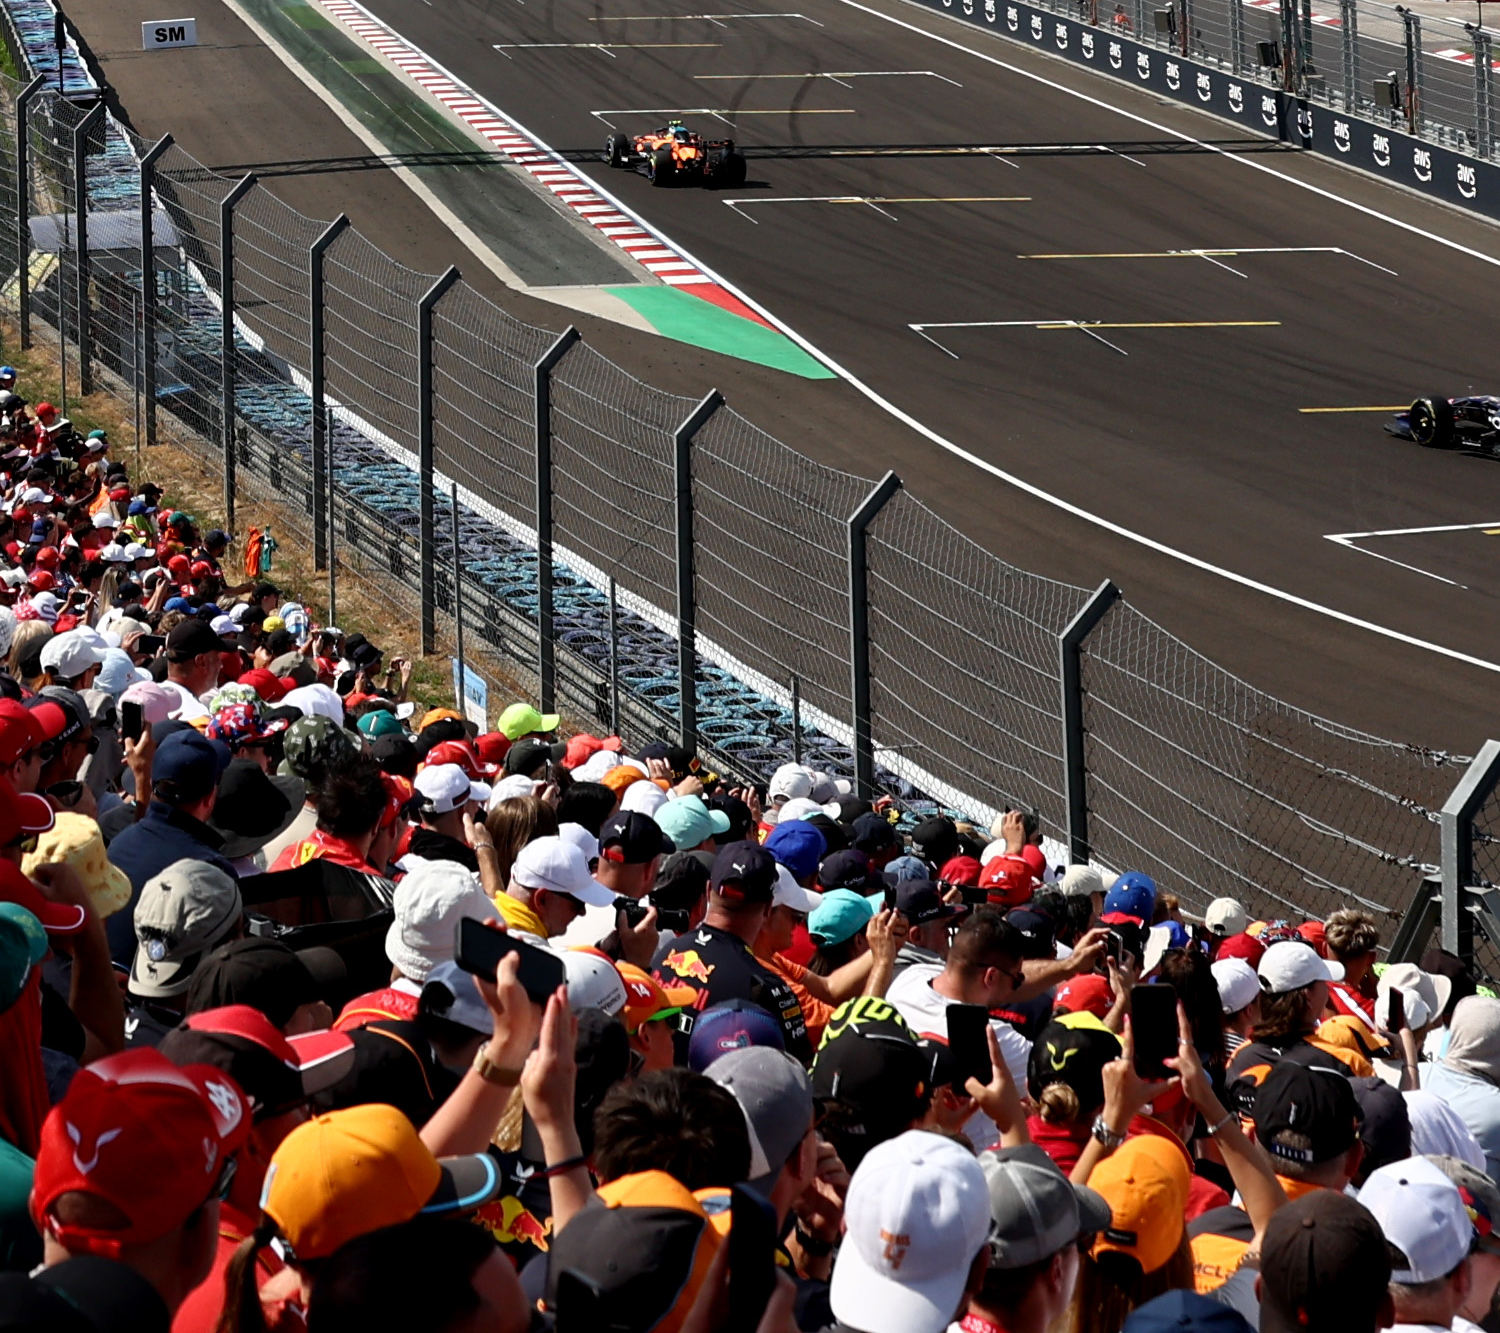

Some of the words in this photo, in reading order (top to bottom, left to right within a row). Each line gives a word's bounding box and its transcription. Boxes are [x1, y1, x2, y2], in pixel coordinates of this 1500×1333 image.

[155, 26, 186, 43] SM
[1197, 72, 1211, 90] aws
[1229, 83, 1243, 101] aws
[1262, 95, 1276, 114] aws
[1334, 119, 1350, 140] aws
[1373, 134, 1390, 154] aws
[1414, 148, 1431, 169] aws
[1458, 164, 1476, 185] aws
[844, 876, 866, 887] CarNext
[918, 907, 940, 919] CarNext
[630, 983, 652, 999] 14
[205, 1081, 236, 1123] 44
